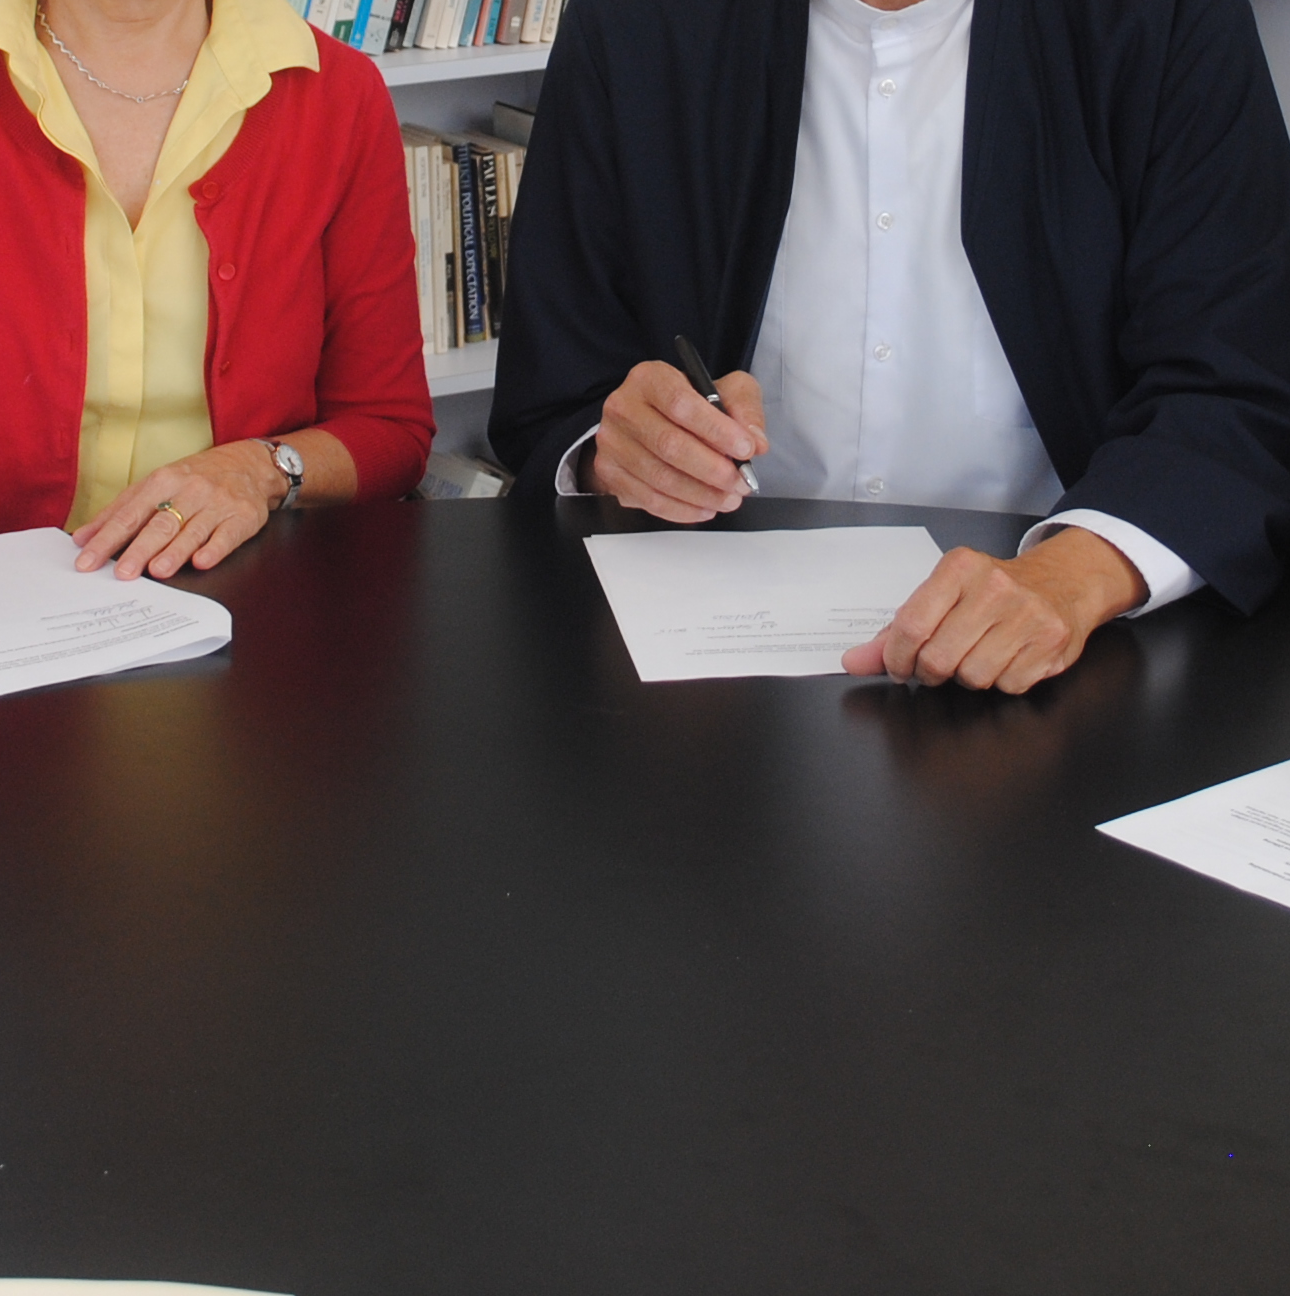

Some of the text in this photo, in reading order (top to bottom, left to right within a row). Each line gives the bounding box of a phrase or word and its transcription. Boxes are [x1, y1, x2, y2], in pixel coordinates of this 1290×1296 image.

[480, 154, 499, 216] PAULUS
[459, 192, 475, 246] POLITICAL
[463, 249, 481, 319] EXPECTATION
